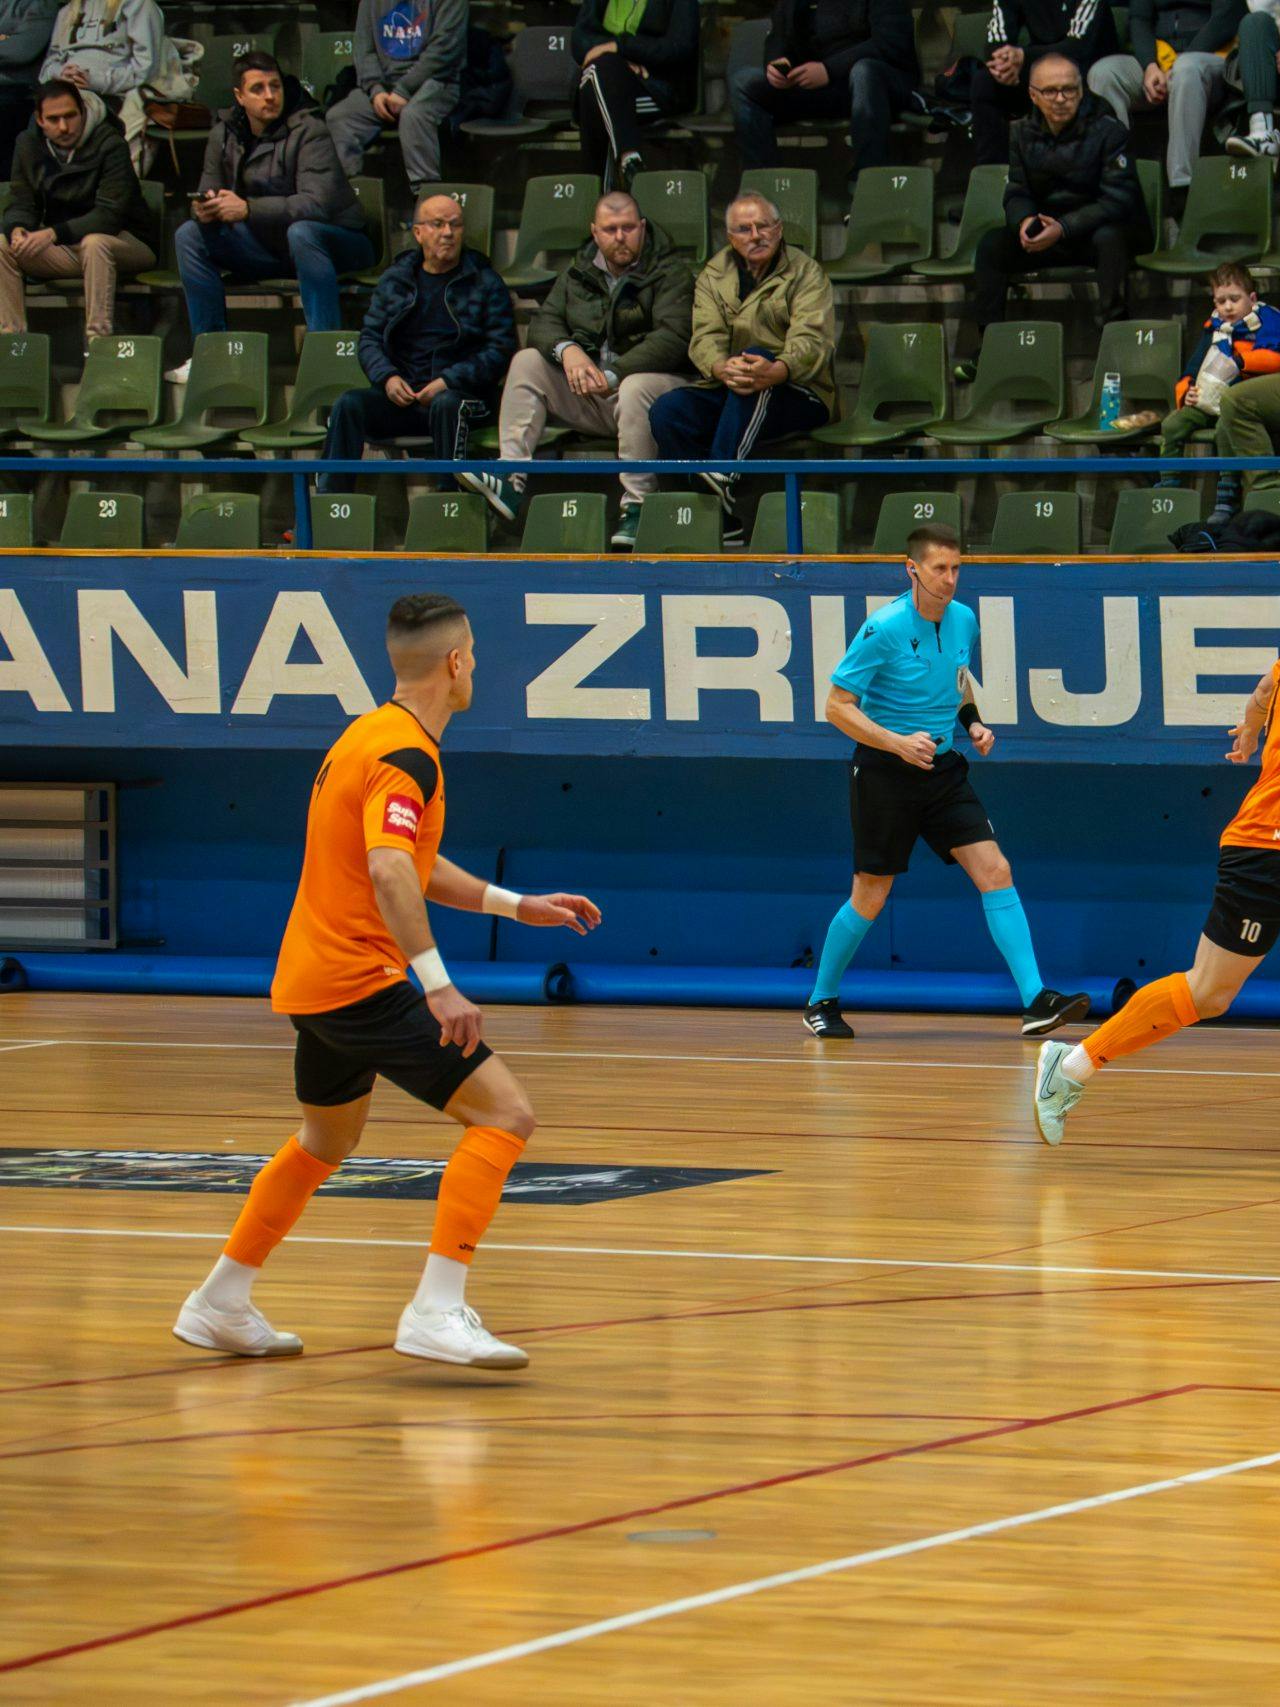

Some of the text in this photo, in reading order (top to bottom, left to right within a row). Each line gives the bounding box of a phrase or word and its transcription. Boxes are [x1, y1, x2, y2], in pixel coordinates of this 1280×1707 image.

[383, 24, 421, 39] NASA
[334, 42, 353, 58] 23
[549, 35, 566, 51] 21
[1229, 164, 1247, 180] 14
[666, 180, 682, 196] 21
[891, 175, 908, 189] 17
[553, 184, 574, 199] 20
[1018, 330, 1036, 346] 15
[1136, 330, 1154, 346] 14
[117, 341, 135, 358] 23
[228, 342, 244, 359] 19
[337, 341, 356, 357] 22
[99, 500, 117, 518] 23
[330, 503, 351, 519] 30
[442, 503, 459, 517] 12
[562, 499, 578, 518] 15
[913, 503, 935, 519] 29
[1035, 501, 1054, 517] 19
[1152, 499, 1174, 514] 30
[676, 507, 693, 525] 10
[1239, 918, 1262, 943] 10
